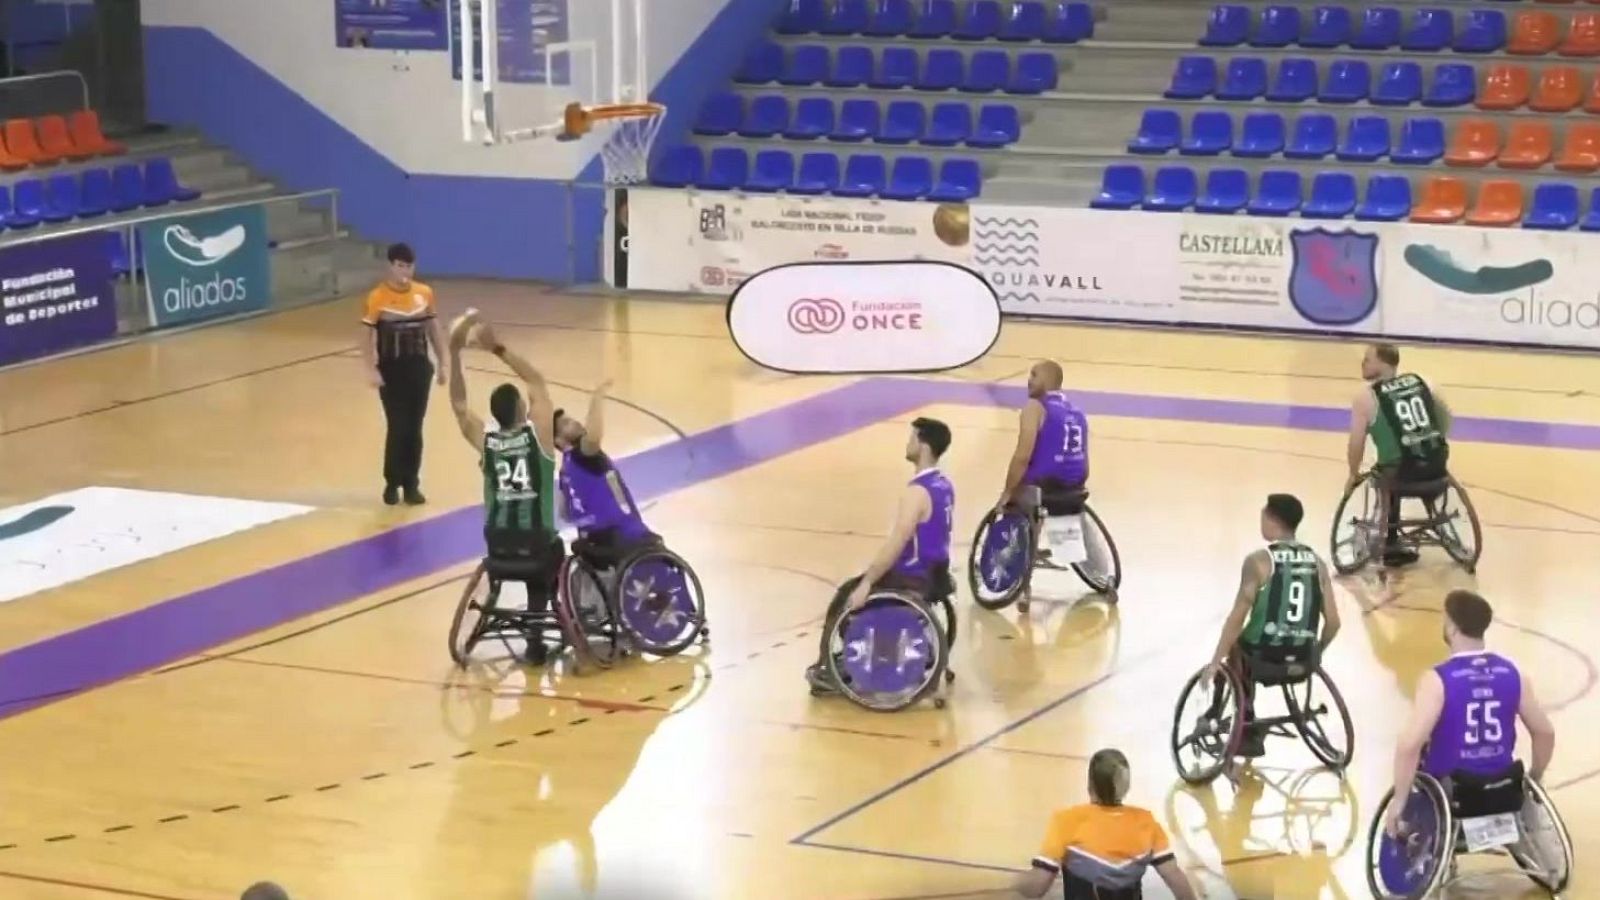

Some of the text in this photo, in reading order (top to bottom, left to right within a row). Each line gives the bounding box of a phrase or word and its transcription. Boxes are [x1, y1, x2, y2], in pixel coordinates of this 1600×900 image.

[818, 223, 831, 231] EN
[834, 224, 860, 233] SILLA
[862, 224, 875, 234] DE
[1179, 233, 1283, 256] CASTELLANA
[2, 268, 75, 291] Fundación
[163, 272, 247, 312] aliados
[978, 270, 1103, 290] QUAVALL
[3, 282, 76, 309] Municipal
[5, 296, 99, 325] de Deportes
[852, 313, 923, 331] ONCE
[1395, 396, 1431, 431] 90
[1062, 423, 1083, 454] 13
[495, 458, 533, 490] 24
[1286, 581, 1305, 622] 9
[1464, 700, 1503, 744] 55
